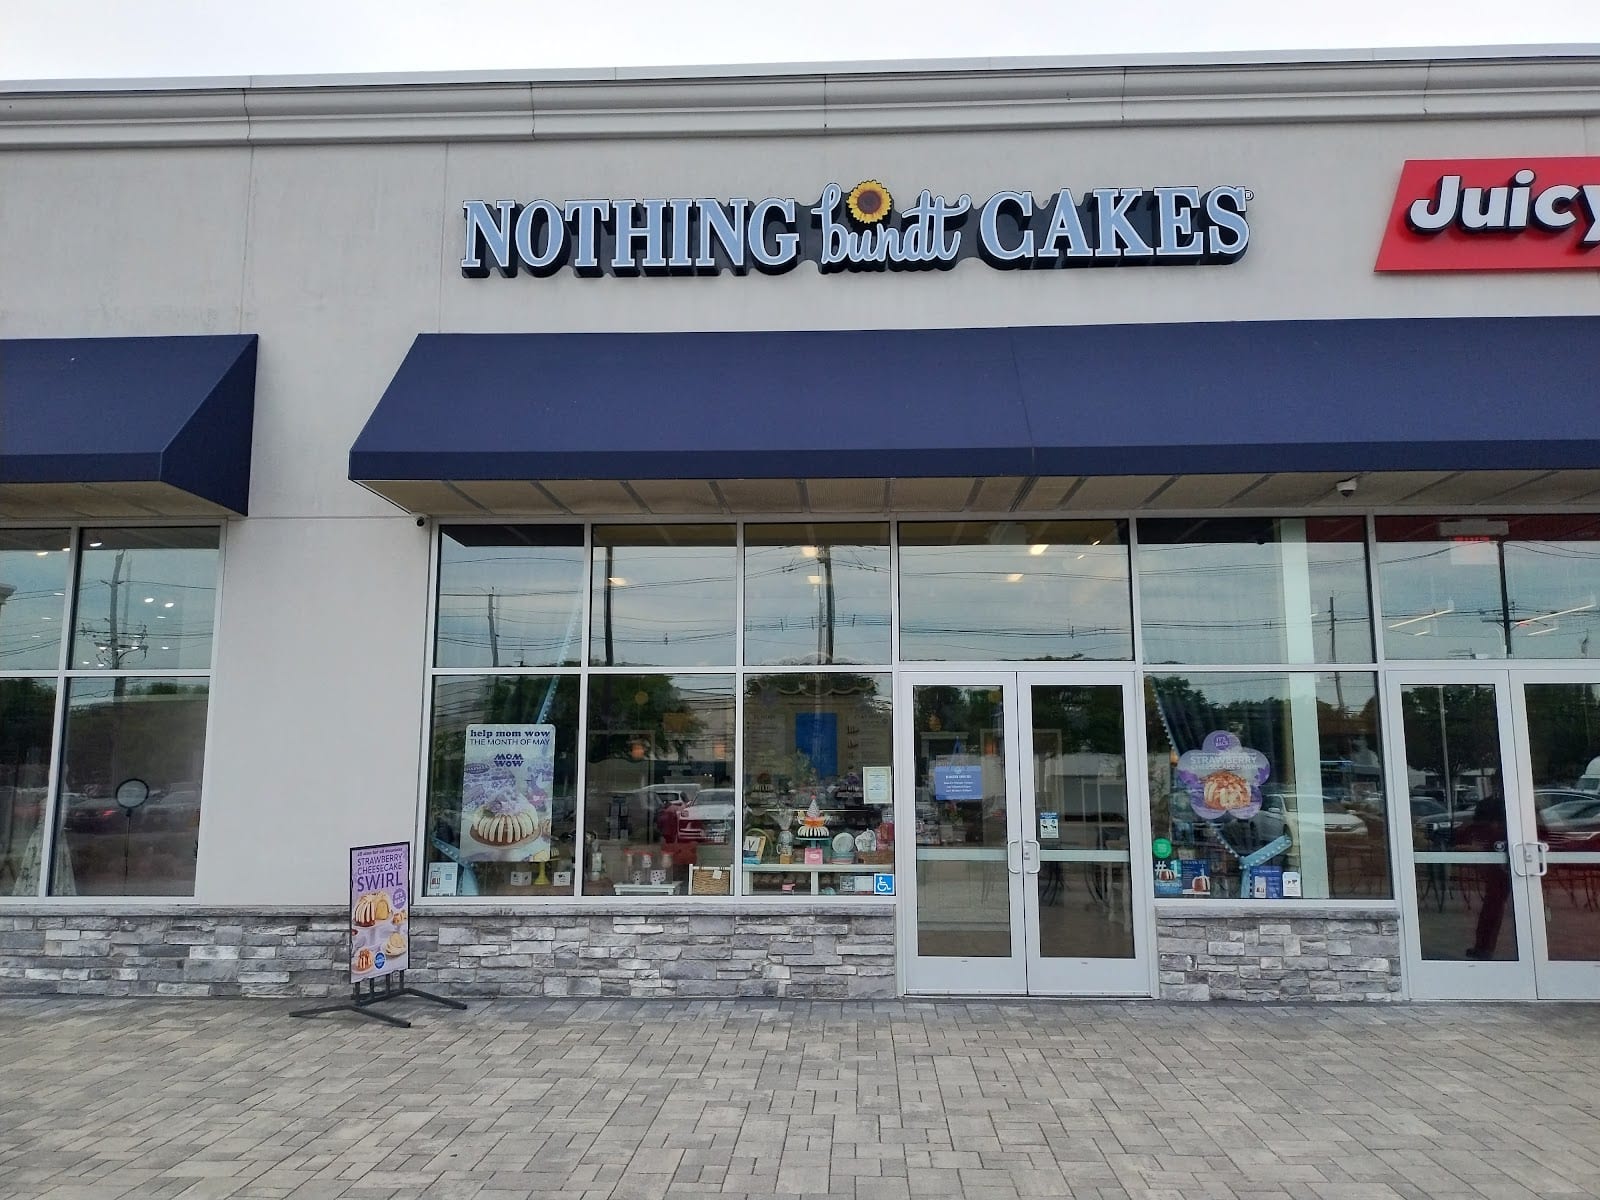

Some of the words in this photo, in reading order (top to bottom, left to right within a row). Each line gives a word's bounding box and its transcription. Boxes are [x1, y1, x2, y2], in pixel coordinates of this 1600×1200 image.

[461, 197, 799, 271] NOTHING
[811, 182, 972, 265] bundt
[979, 185, 1251, 260] CAKES
[470, 730, 492, 738] help
[1189, 755, 1258, 765] STRAWBERRY
[357, 852, 403, 867] STRAWBERRY
[357, 861, 403, 876] CHEESECAKE
[358, 871, 402, 892] SWIRL
